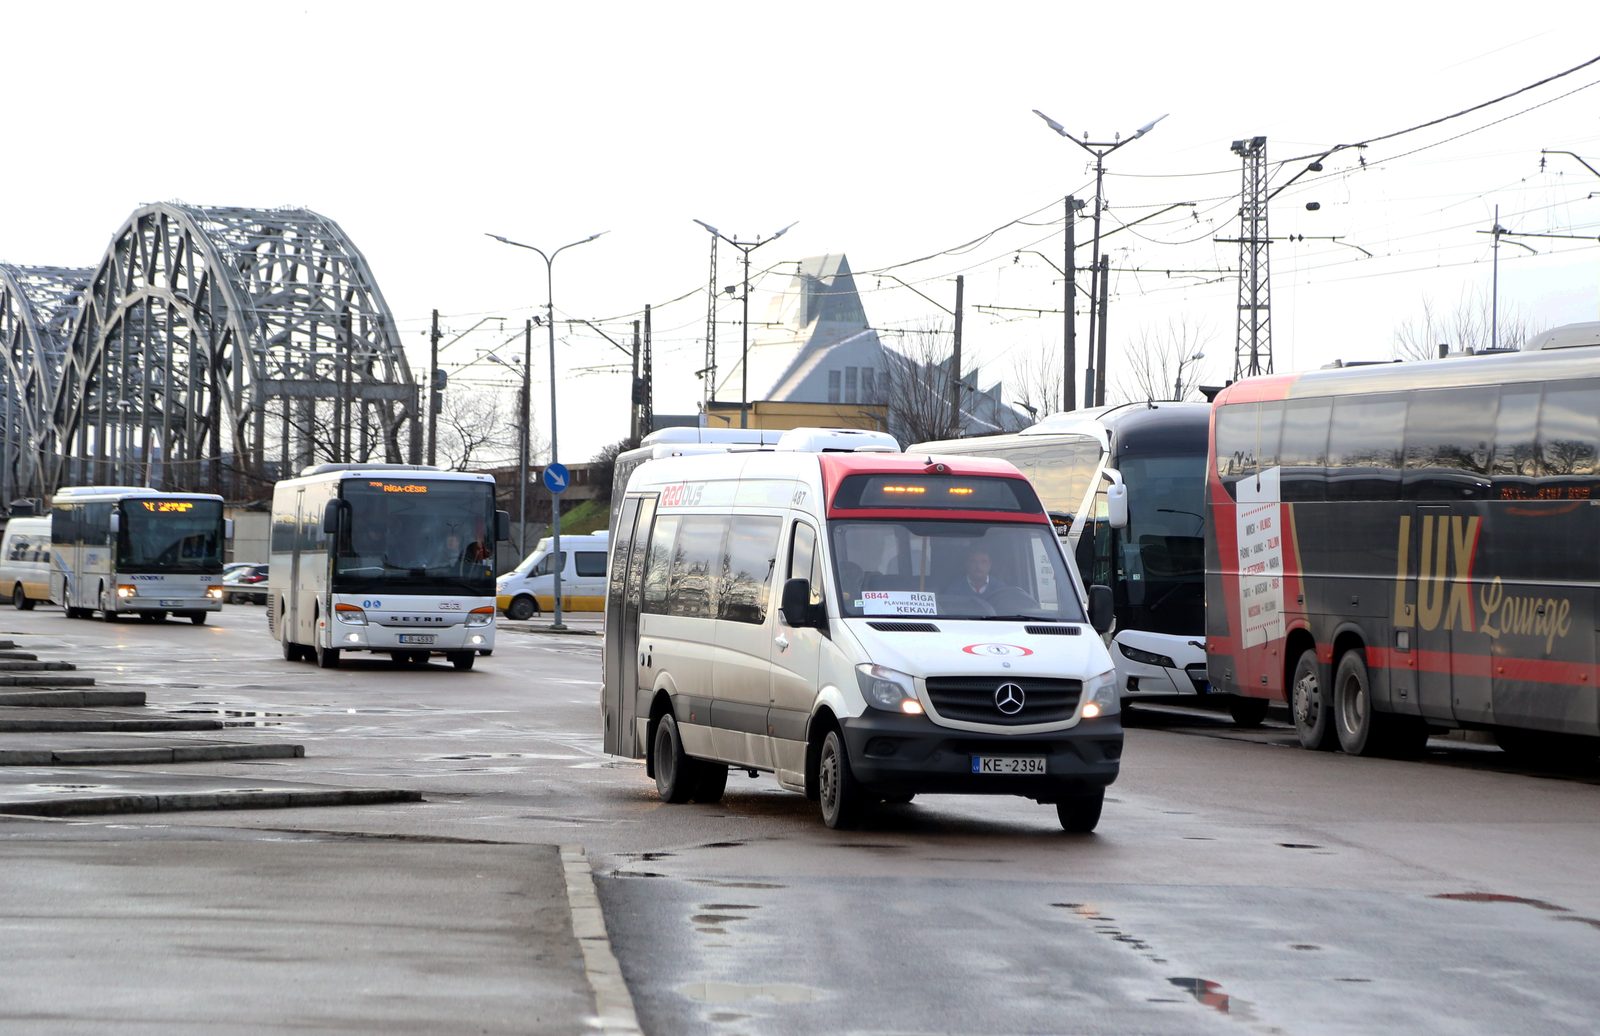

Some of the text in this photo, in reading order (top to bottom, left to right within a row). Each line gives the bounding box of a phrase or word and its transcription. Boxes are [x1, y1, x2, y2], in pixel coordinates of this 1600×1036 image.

[1393, 515, 1571, 656] LUX Lounge
[864, 592, 934, 602] 6844 RĪGA
[983, 758, 1044, 773] KE-2394
